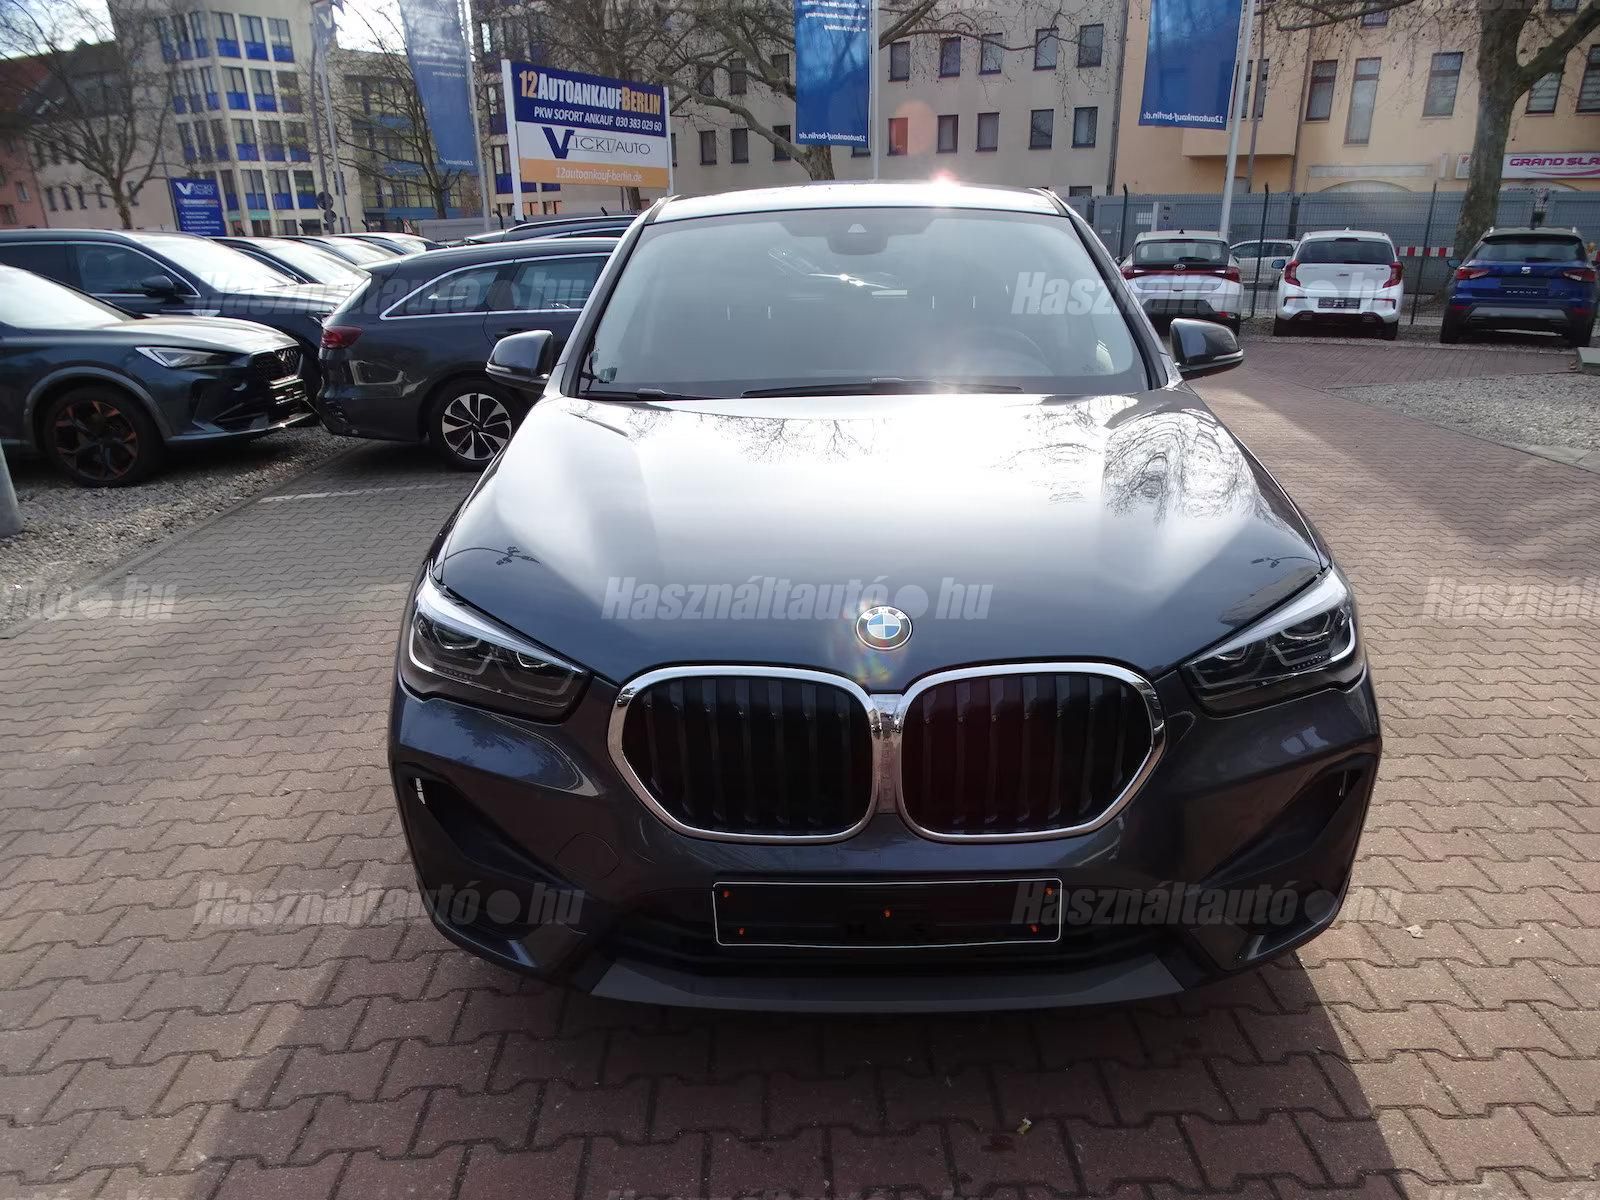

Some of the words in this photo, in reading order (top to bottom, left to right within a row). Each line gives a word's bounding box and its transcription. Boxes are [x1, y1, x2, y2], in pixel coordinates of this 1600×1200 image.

[534, 106, 553, 118] PKW
[554, 108, 584, 123] SOFORT
[584, 112, 614, 126] ANKAUF
[615, 117, 628, 128] 030
[641, 119, 654, 131] 029
[654, 121, 662, 131] 60
[1509, 157, 1565, 167] GRAND
[556, 166, 643, 183] 12autoankauf-berlin.de
